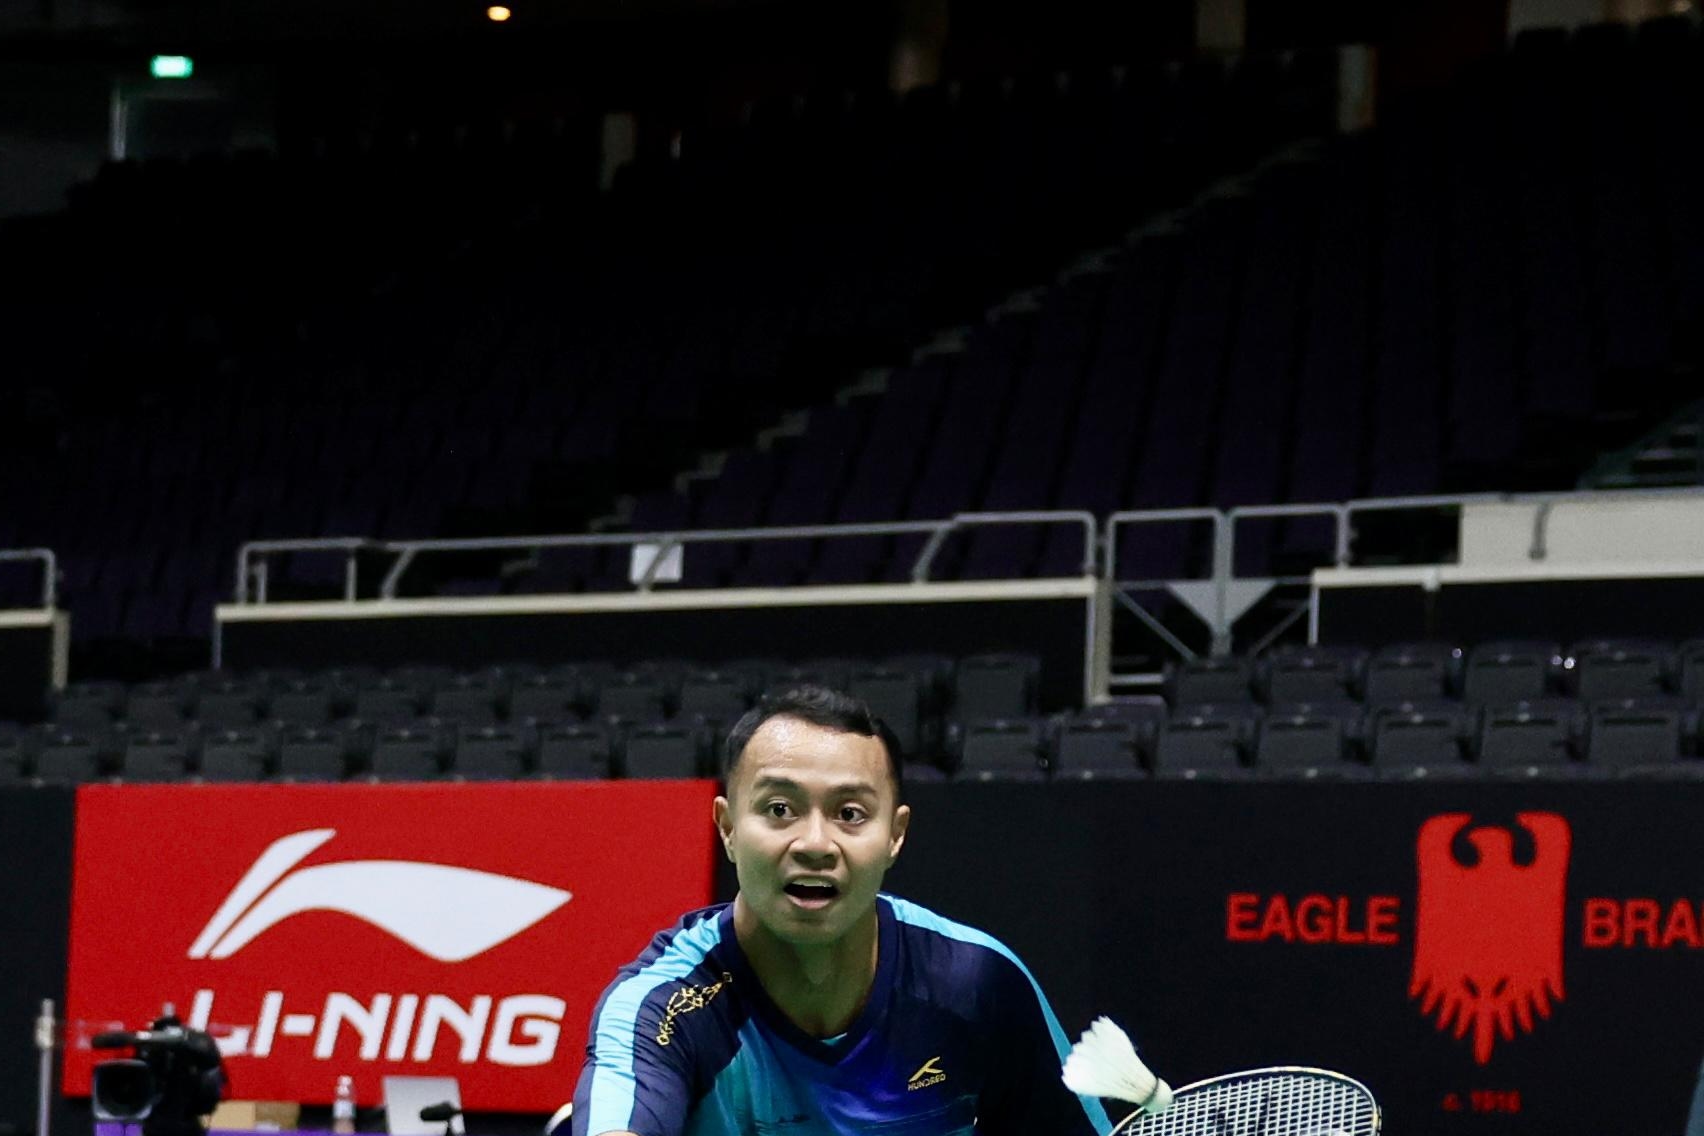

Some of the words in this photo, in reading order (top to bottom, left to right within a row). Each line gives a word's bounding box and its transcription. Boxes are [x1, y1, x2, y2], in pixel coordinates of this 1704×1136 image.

[1225, 894, 1400, 943] EAGLE
[1583, 897, 1704, 950] BRA
[189, 988, 566, 1066] LI-NING
